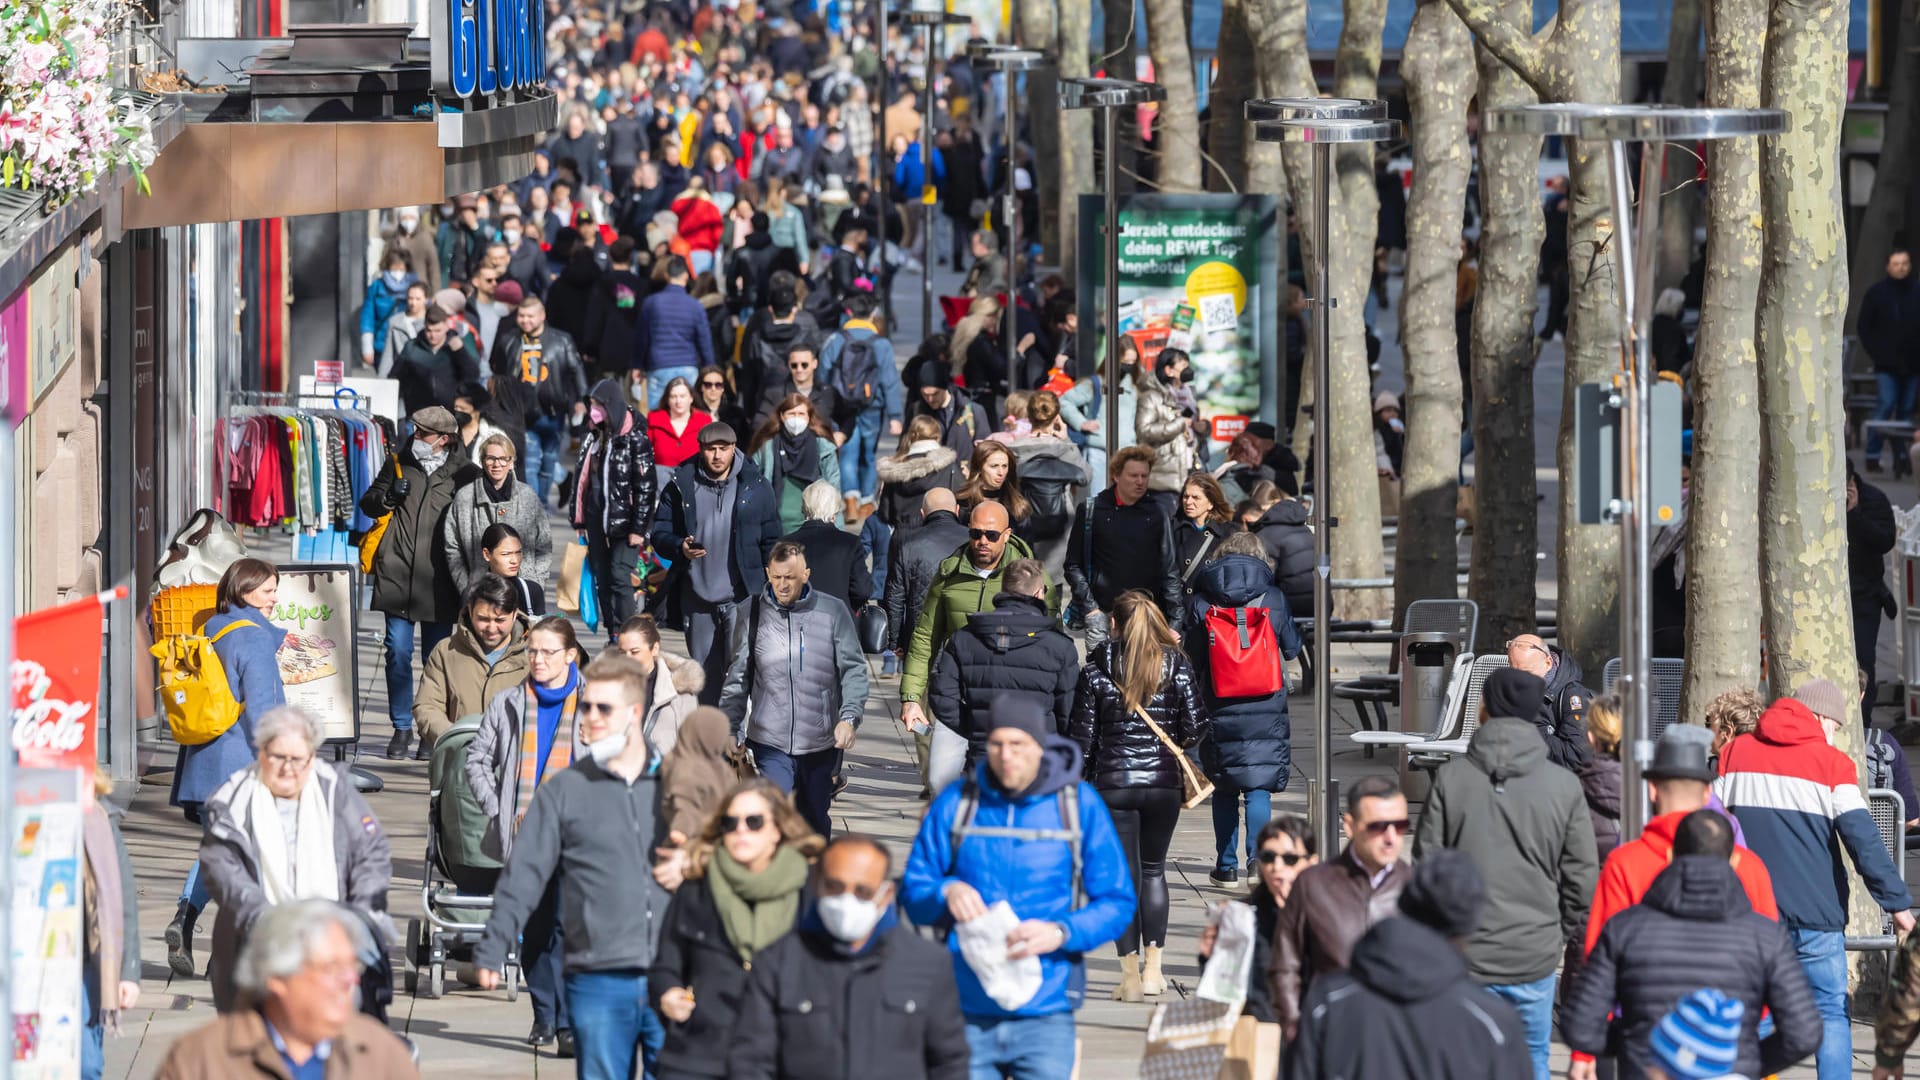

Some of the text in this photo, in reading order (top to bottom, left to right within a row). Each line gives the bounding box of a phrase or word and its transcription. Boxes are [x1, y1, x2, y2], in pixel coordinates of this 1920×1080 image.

[1171, 222, 1246, 237] entdecken:
[1125, 240, 1244, 258] deine REWE Top-
